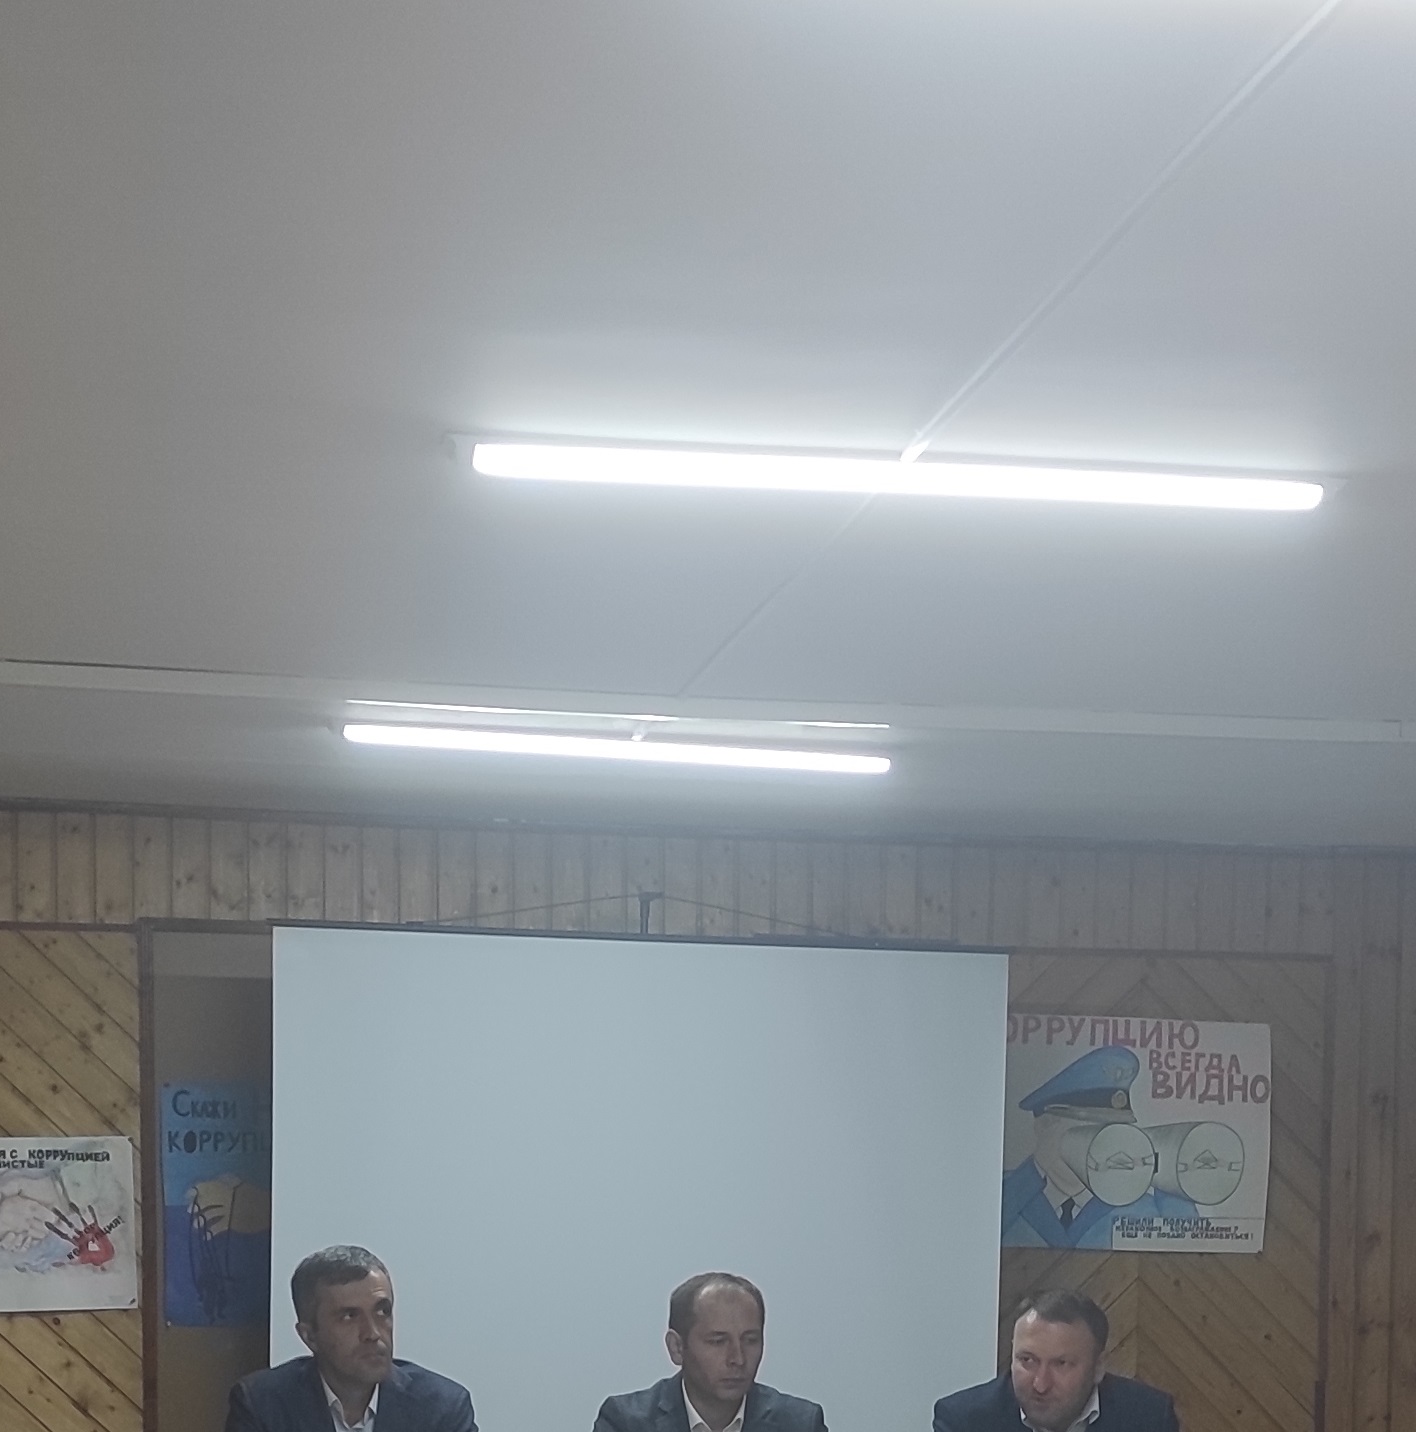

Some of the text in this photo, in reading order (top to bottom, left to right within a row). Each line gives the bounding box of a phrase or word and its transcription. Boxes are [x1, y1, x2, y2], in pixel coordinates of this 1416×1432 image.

[1148, 1049, 1242, 1075] ВСЕГДА
[1151, 1070, 1272, 1105] ВИДНО
[9, 1149, 18, 1160] С
[27, 1149, 110, 1162] КОРРУПЦИЕЙ
